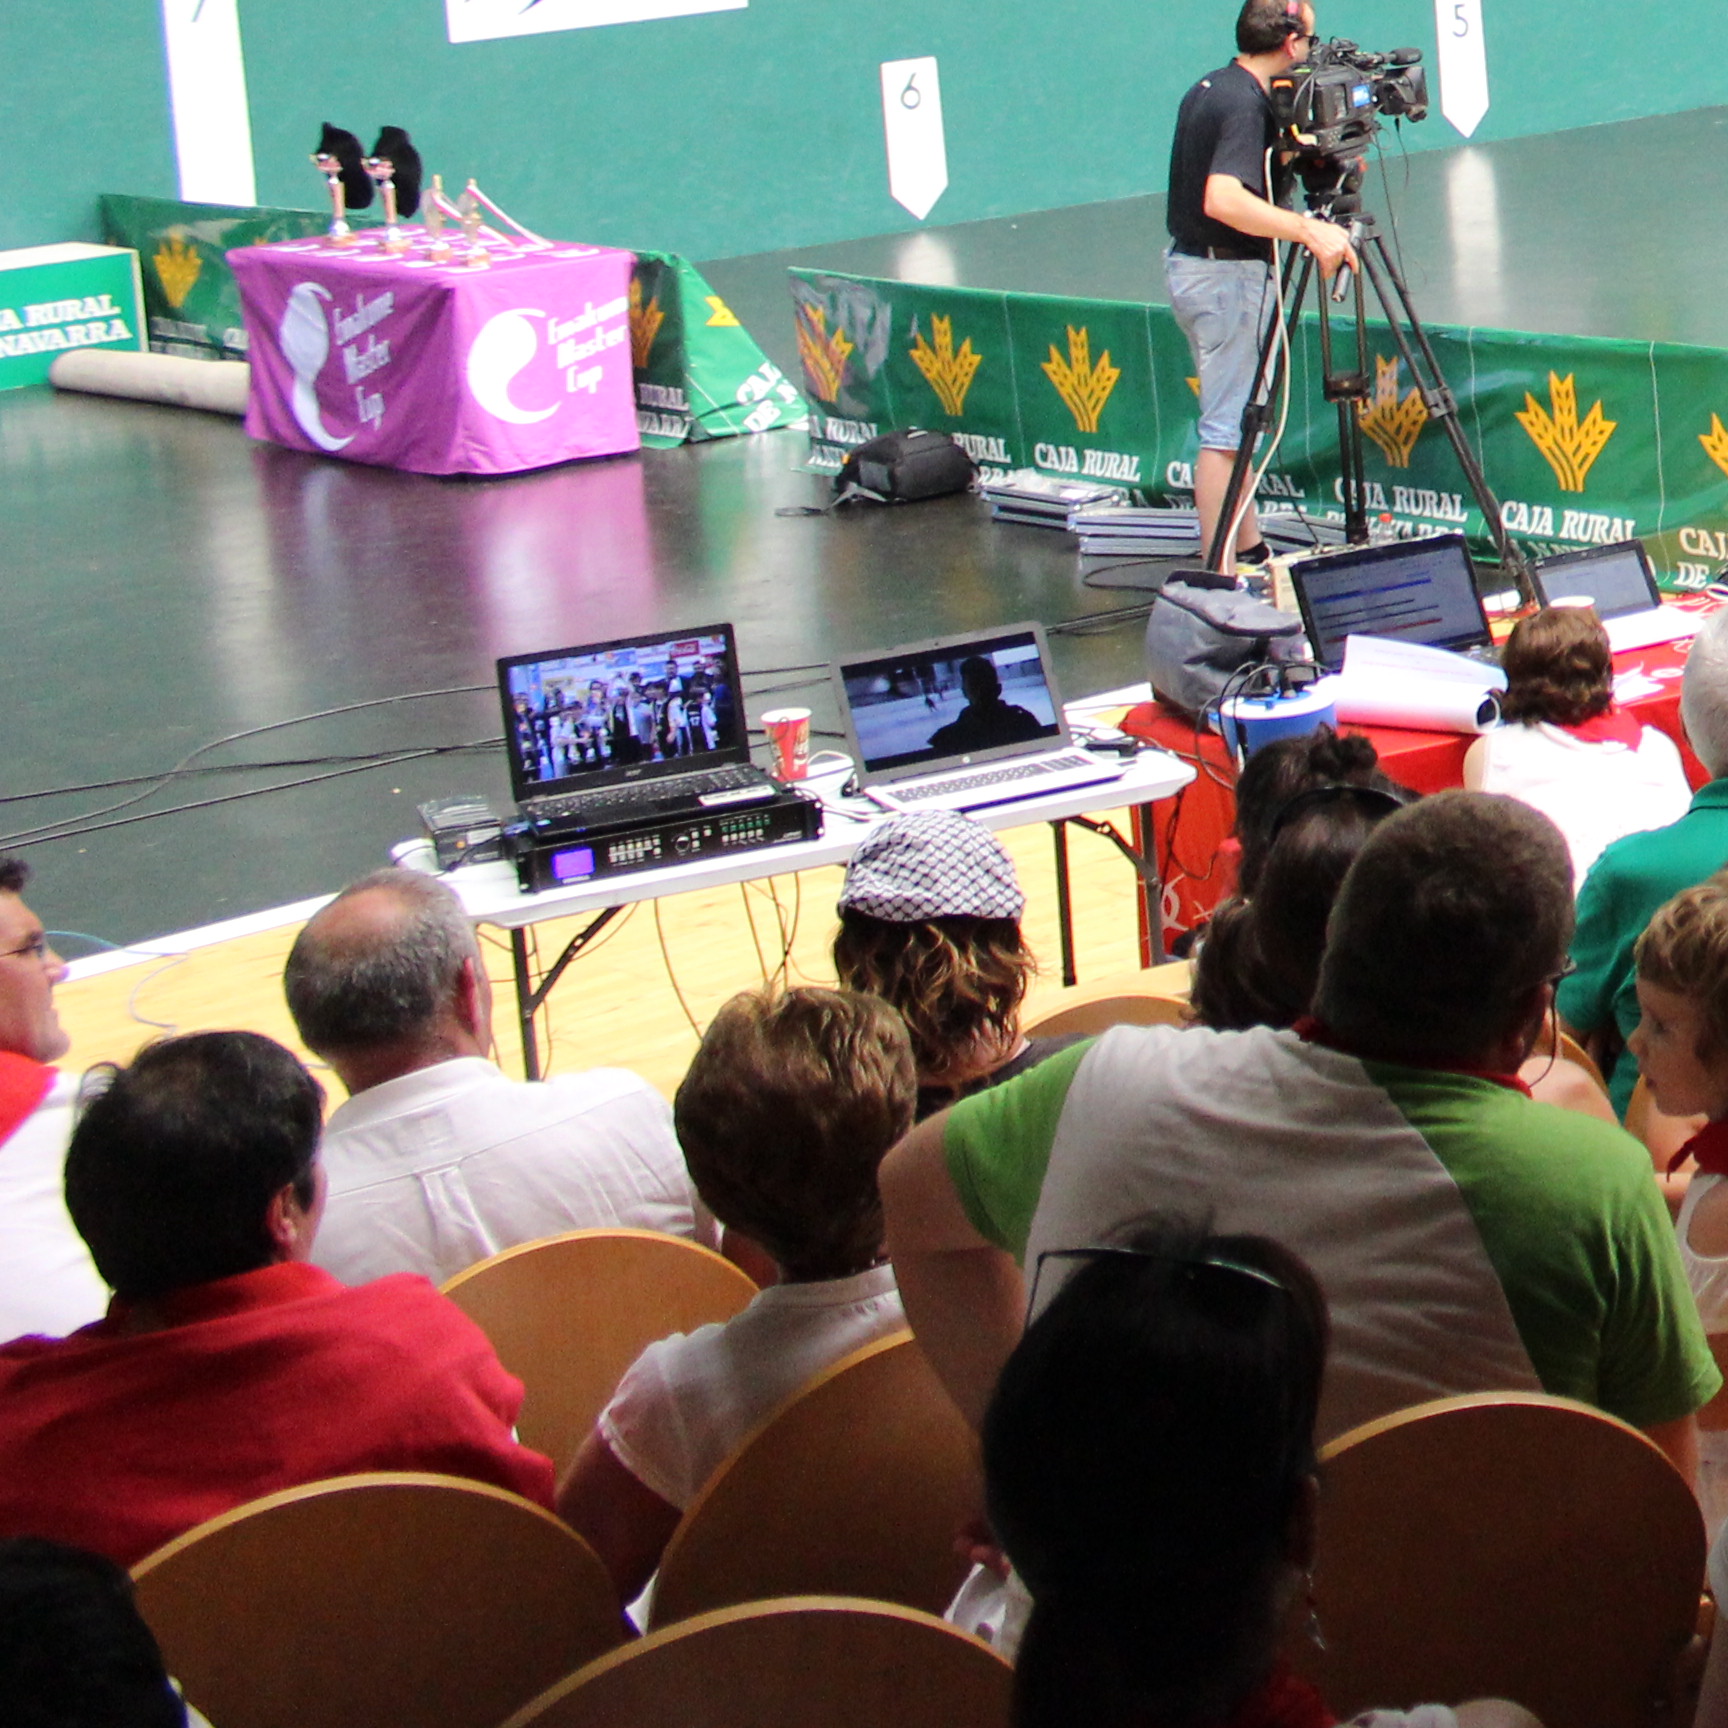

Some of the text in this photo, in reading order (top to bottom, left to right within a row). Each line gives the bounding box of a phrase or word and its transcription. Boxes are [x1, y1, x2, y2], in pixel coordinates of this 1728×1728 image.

[1450, 3, 1470, 38] 5
[900, 72, 922, 111] 6
[24, 294, 123, 326] RURAL
[1034, 442, 1142, 483] CAJA RURAL
[1166, 460, 1196, 489] CA
[1392, 484, 1469, 523] RURAL
[1500, 499, 1555, 538] CAJA
[1673, 561, 1711, 589] DE
